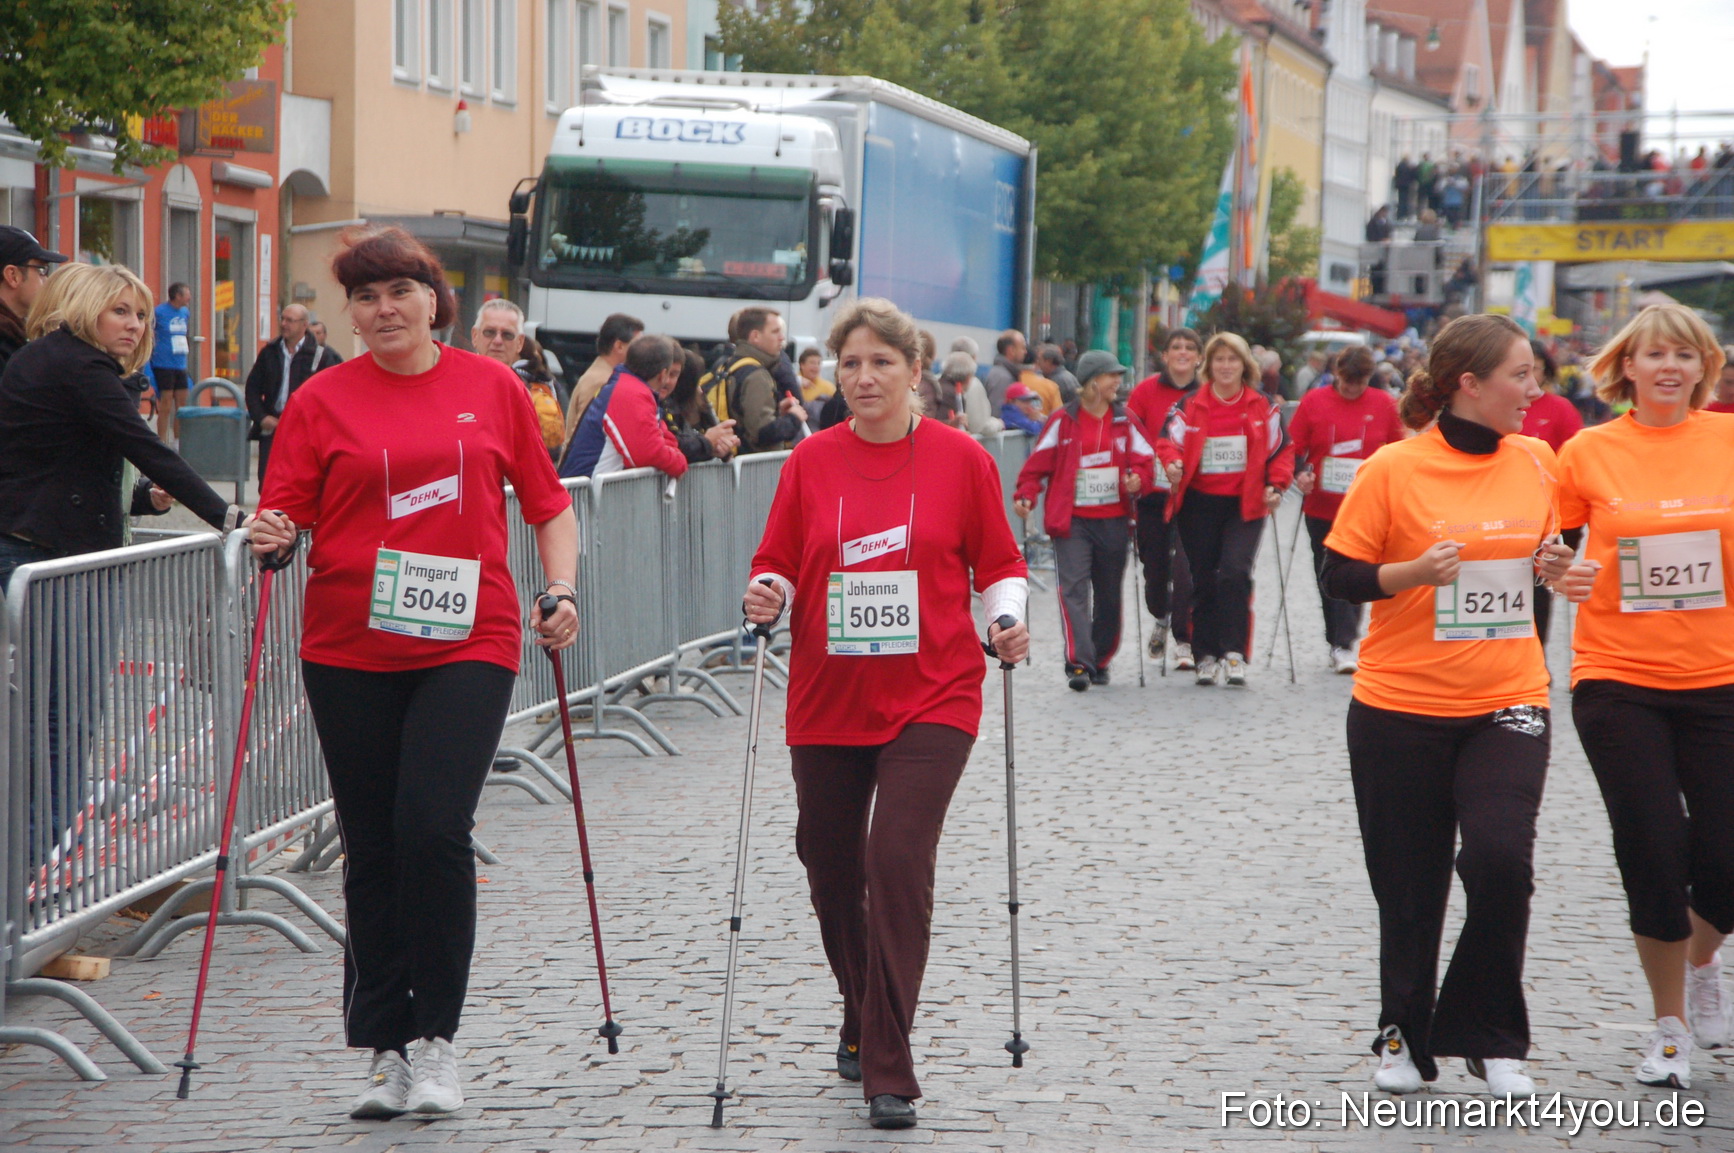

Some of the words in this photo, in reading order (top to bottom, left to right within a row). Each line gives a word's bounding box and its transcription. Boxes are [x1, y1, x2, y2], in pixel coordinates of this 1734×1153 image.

[212, 111, 239, 125] DER
[616, 116, 747, 145] BOCK
[1576, 228, 1670, 252] START
[1215, 450, 1244, 461] 5033
[1335, 472, 1355, 482] 505
[1089, 482, 1116, 494] 5034
[410, 487, 440, 507] DEHN
[861, 537, 889, 554] DEHN
[404, 560, 459, 582] Irmgard
[1649, 561, 1713, 587] 5217
[377, 581, 384, 592] S
[848, 580, 899, 596] Johanna
[402, 587, 467, 614] 5049
[1464, 590, 1525, 614] 5214
[830, 605, 835, 616] S
[850, 605, 910, 628] 5058
[881, 641, 917, 649] PFLEIDERER
